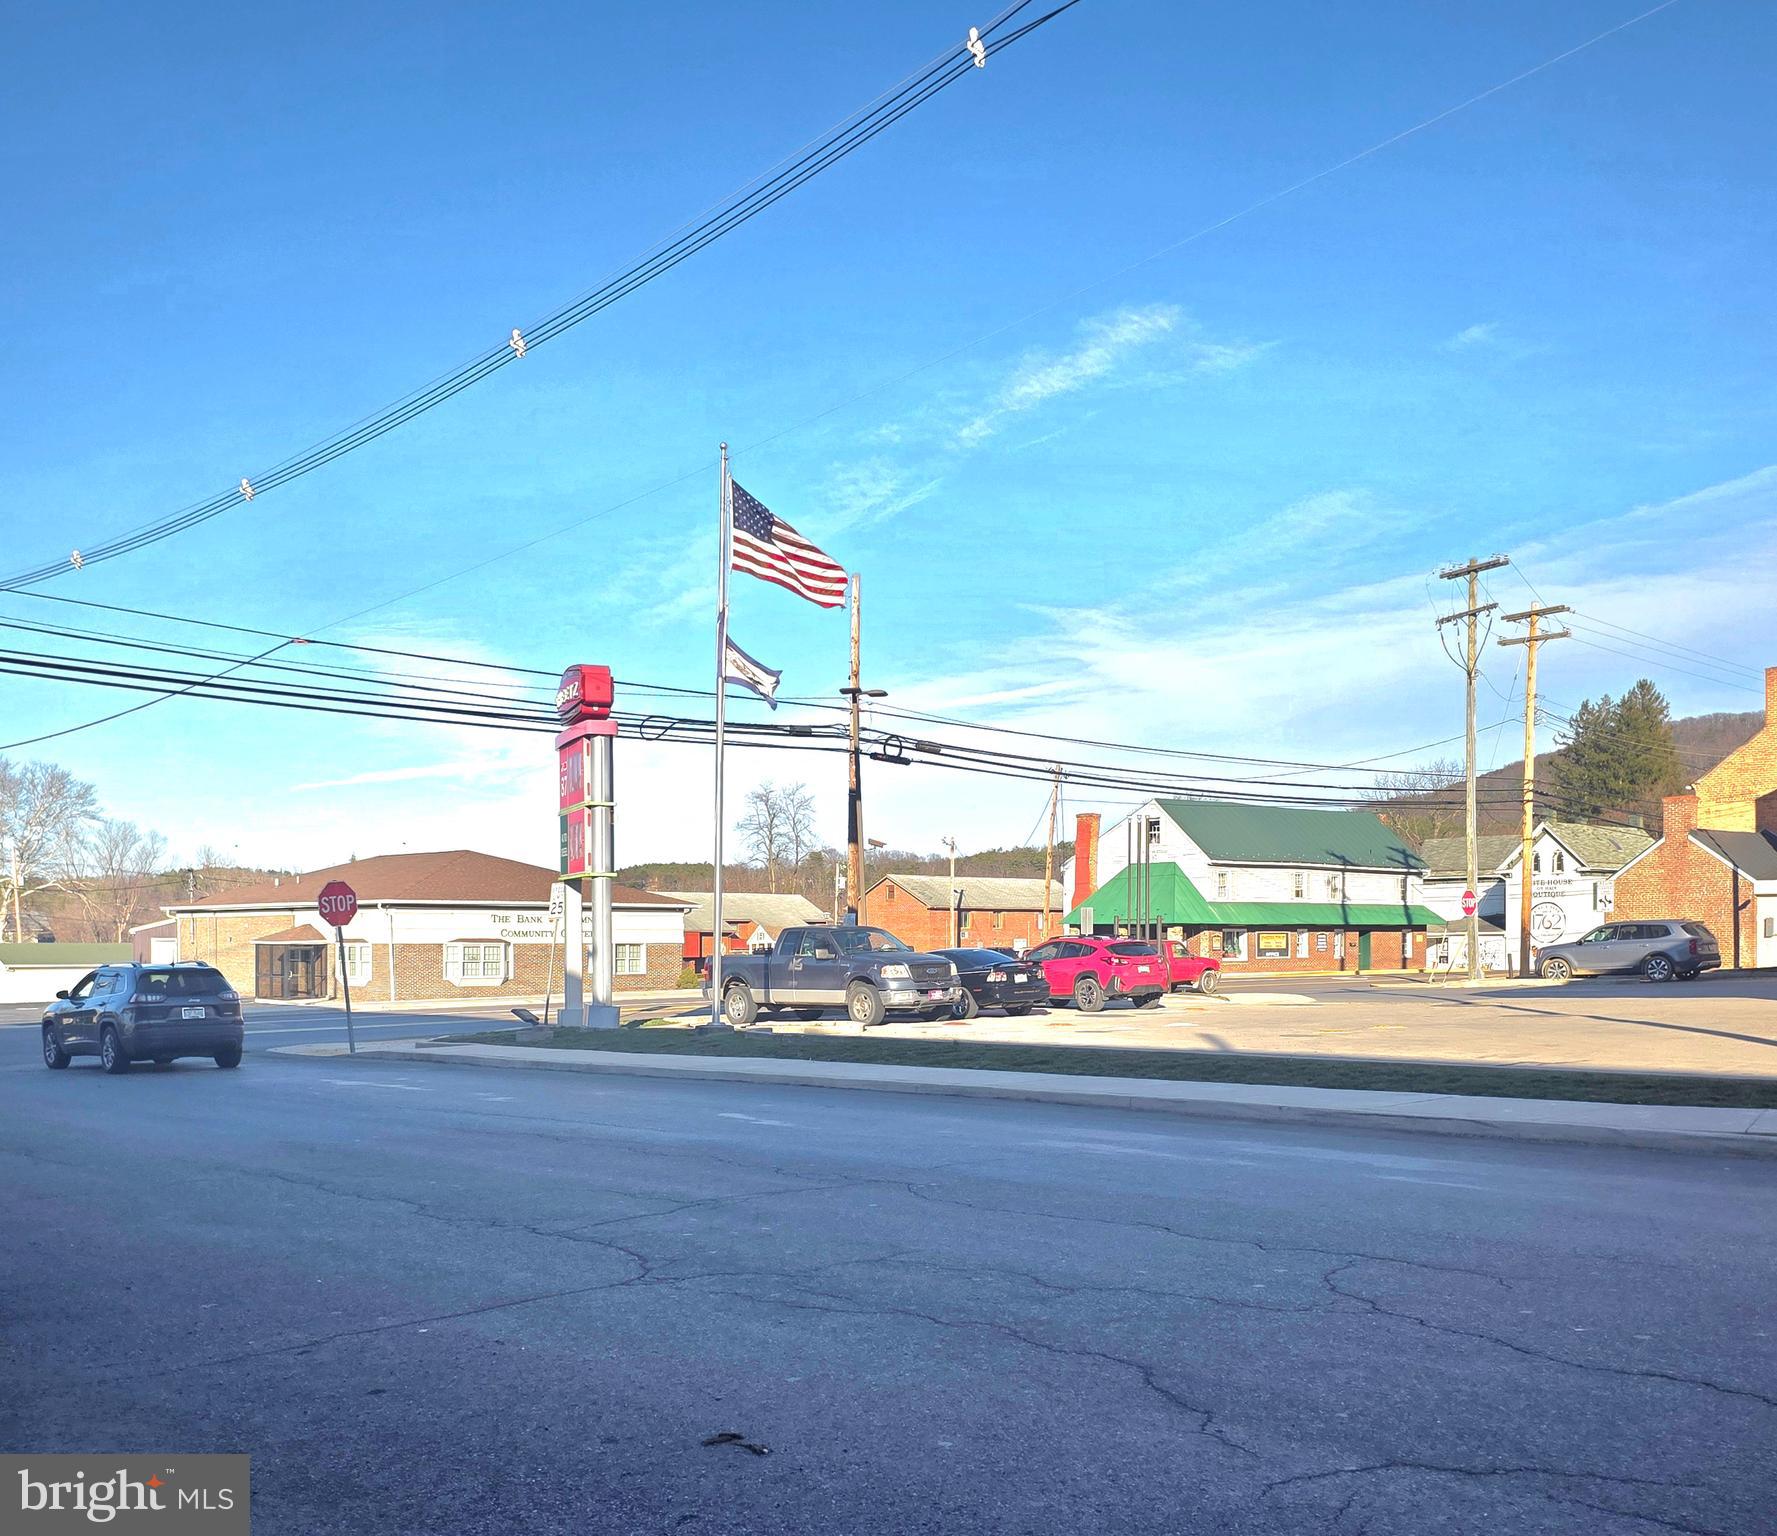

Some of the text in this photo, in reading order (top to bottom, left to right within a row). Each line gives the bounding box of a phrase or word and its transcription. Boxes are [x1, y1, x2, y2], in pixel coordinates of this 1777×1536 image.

[321, 895, 355, 913] STOP
[550, 902, 563, 914] 25
[1462, 898, 1476, 908] STOP
[491, 914, 542, 923] THE BANK
[1532, 913, 1562, 930] 1762
[500, 929, 555, 938] COMMUNITY
